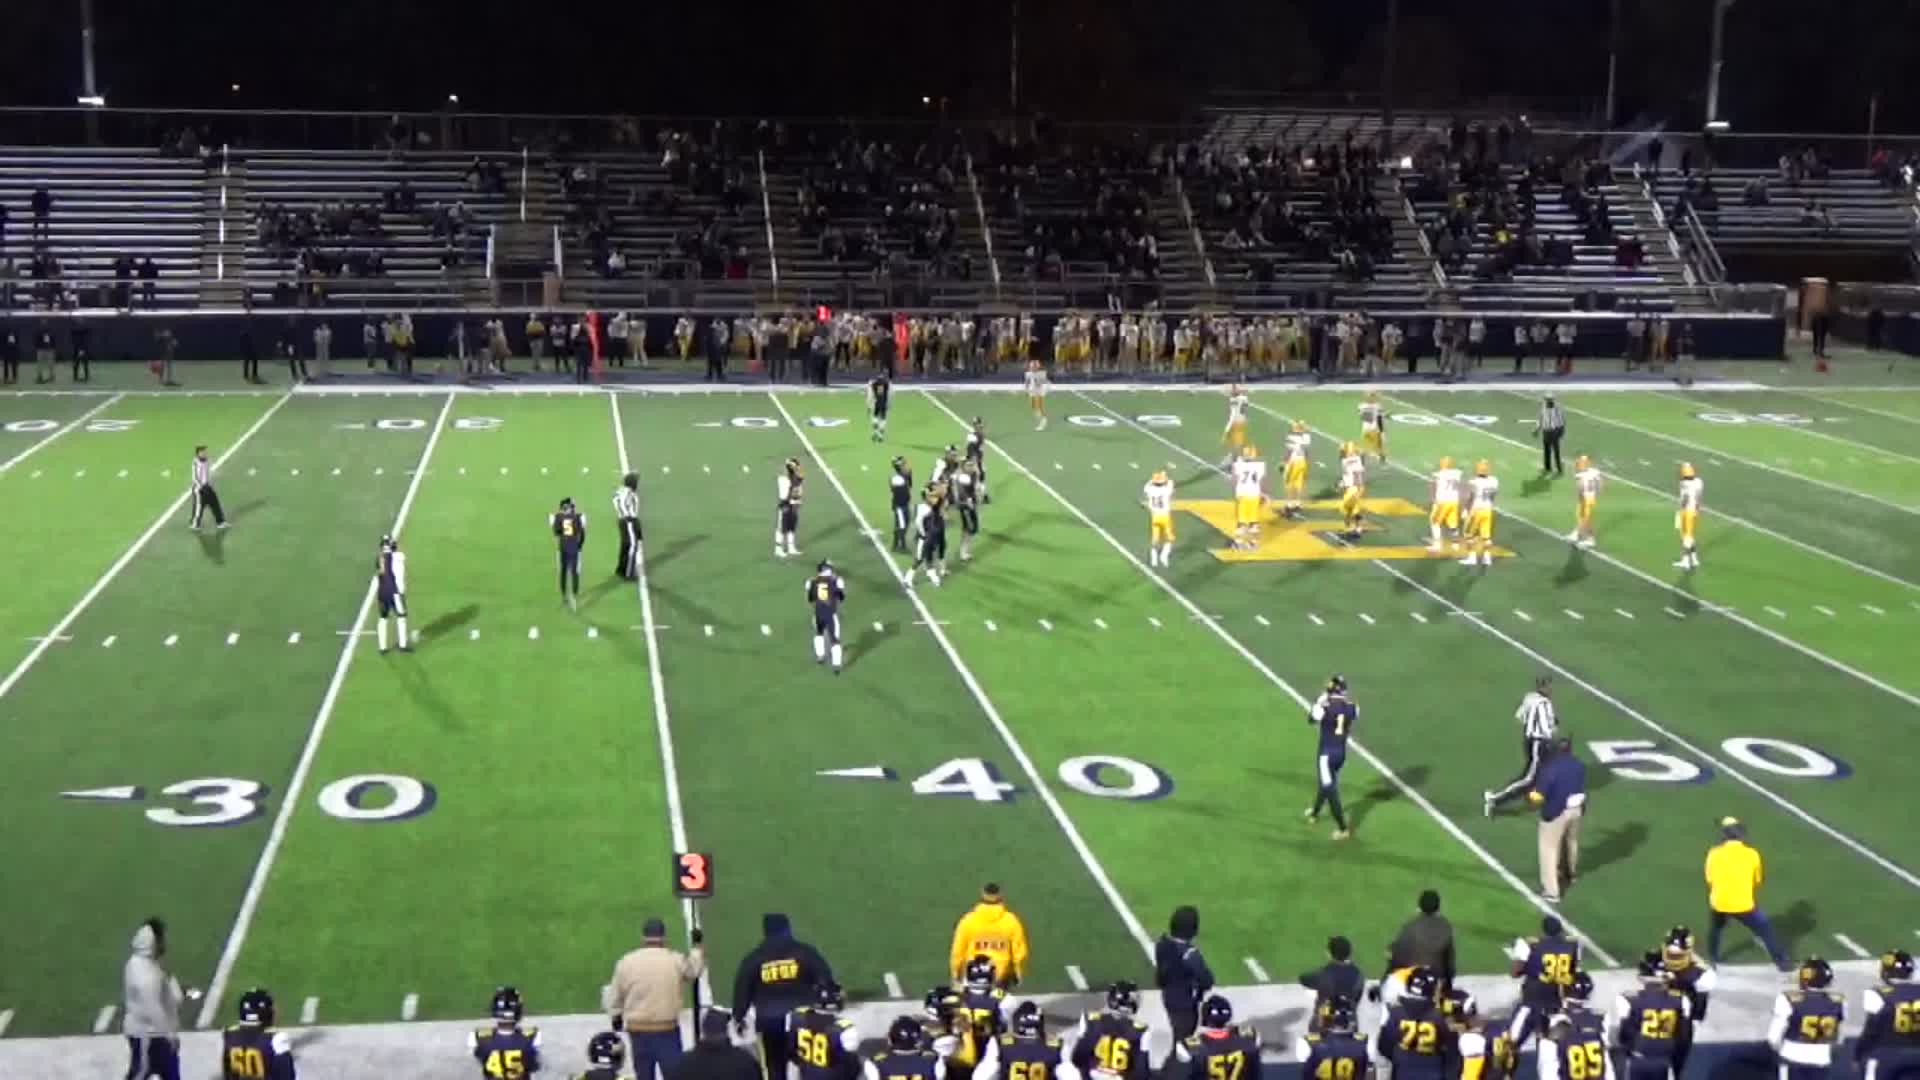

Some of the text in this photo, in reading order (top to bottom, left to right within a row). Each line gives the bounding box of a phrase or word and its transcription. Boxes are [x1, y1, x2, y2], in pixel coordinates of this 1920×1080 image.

[562, 518, 574, 536] 5
[817, 582, 829, 601] 6
[1334, 713, 1345, 736] 1
[680, 853, 706, 890] 3
[1539, 953, 1574, 985] 38
[797, 1027, 829, 1067] 58
[1400, 1019, 1437, 1053] 72
[485, 1049, 525, 1080] 45
[1094, 1035, 1131, 1070] 46
[1207, 1050, 1245, 1080] 57
[1567, 1041, 1603, 1079] 85
